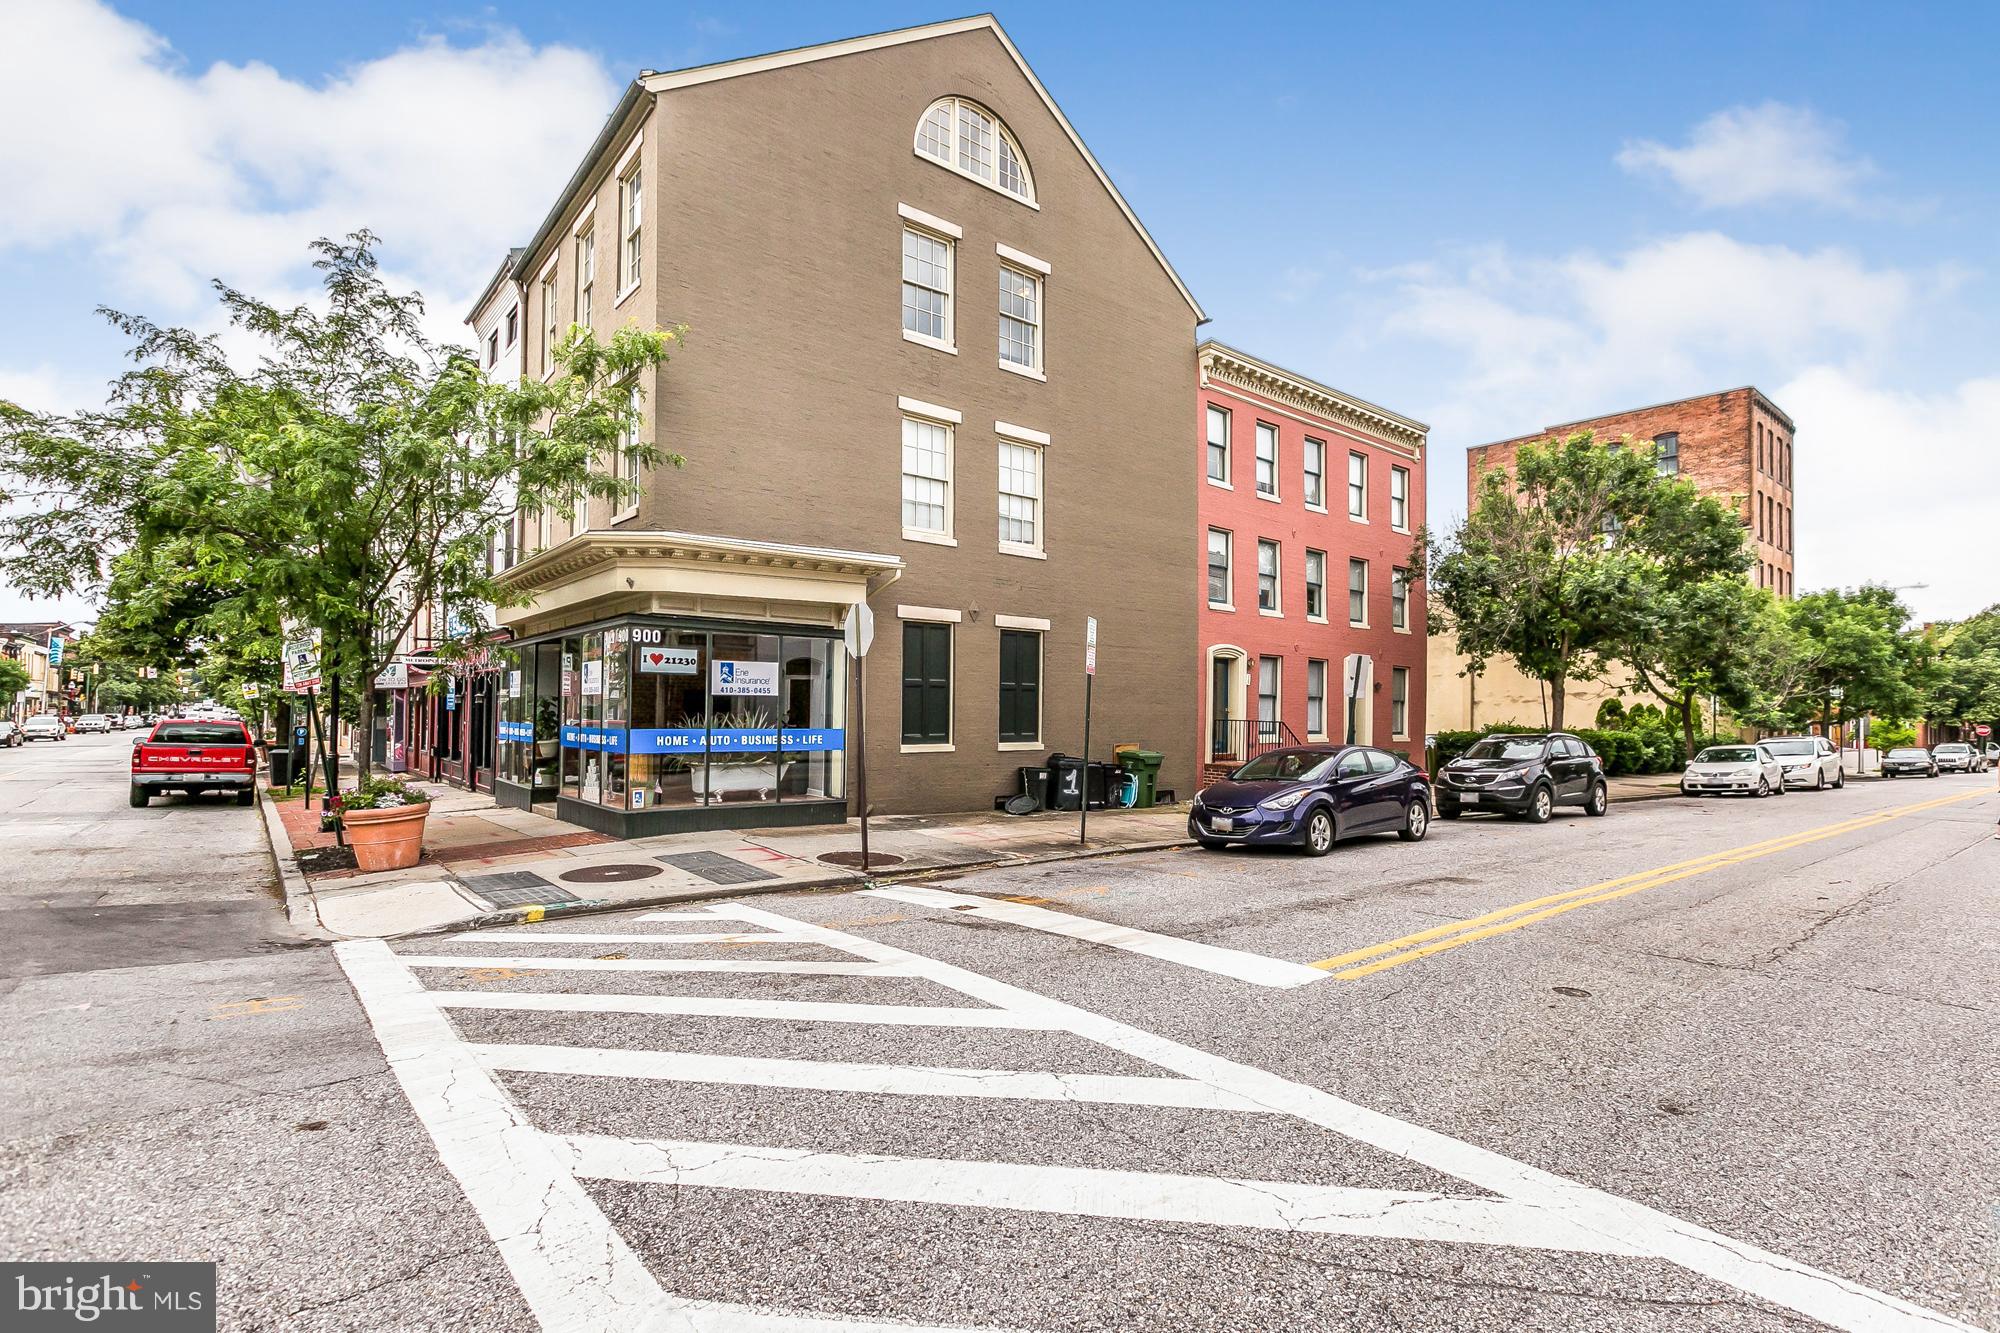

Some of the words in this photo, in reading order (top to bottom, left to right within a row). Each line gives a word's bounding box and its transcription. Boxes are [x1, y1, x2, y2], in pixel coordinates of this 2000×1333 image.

[632, 628, 661, 643] 900
[643, 655, 648, 663] I
[664, 656, 696, 666] 21230
[720, 686, 771, 694] 410-385-0455
[656, 735, 689, 746] HOME
[699, 735, 731, 746] AUTO
[741, 735, 794, 745] BUSINESS
[802, 734, 823, 745] LIFE
[1063, 769, 1079, 795] 1
